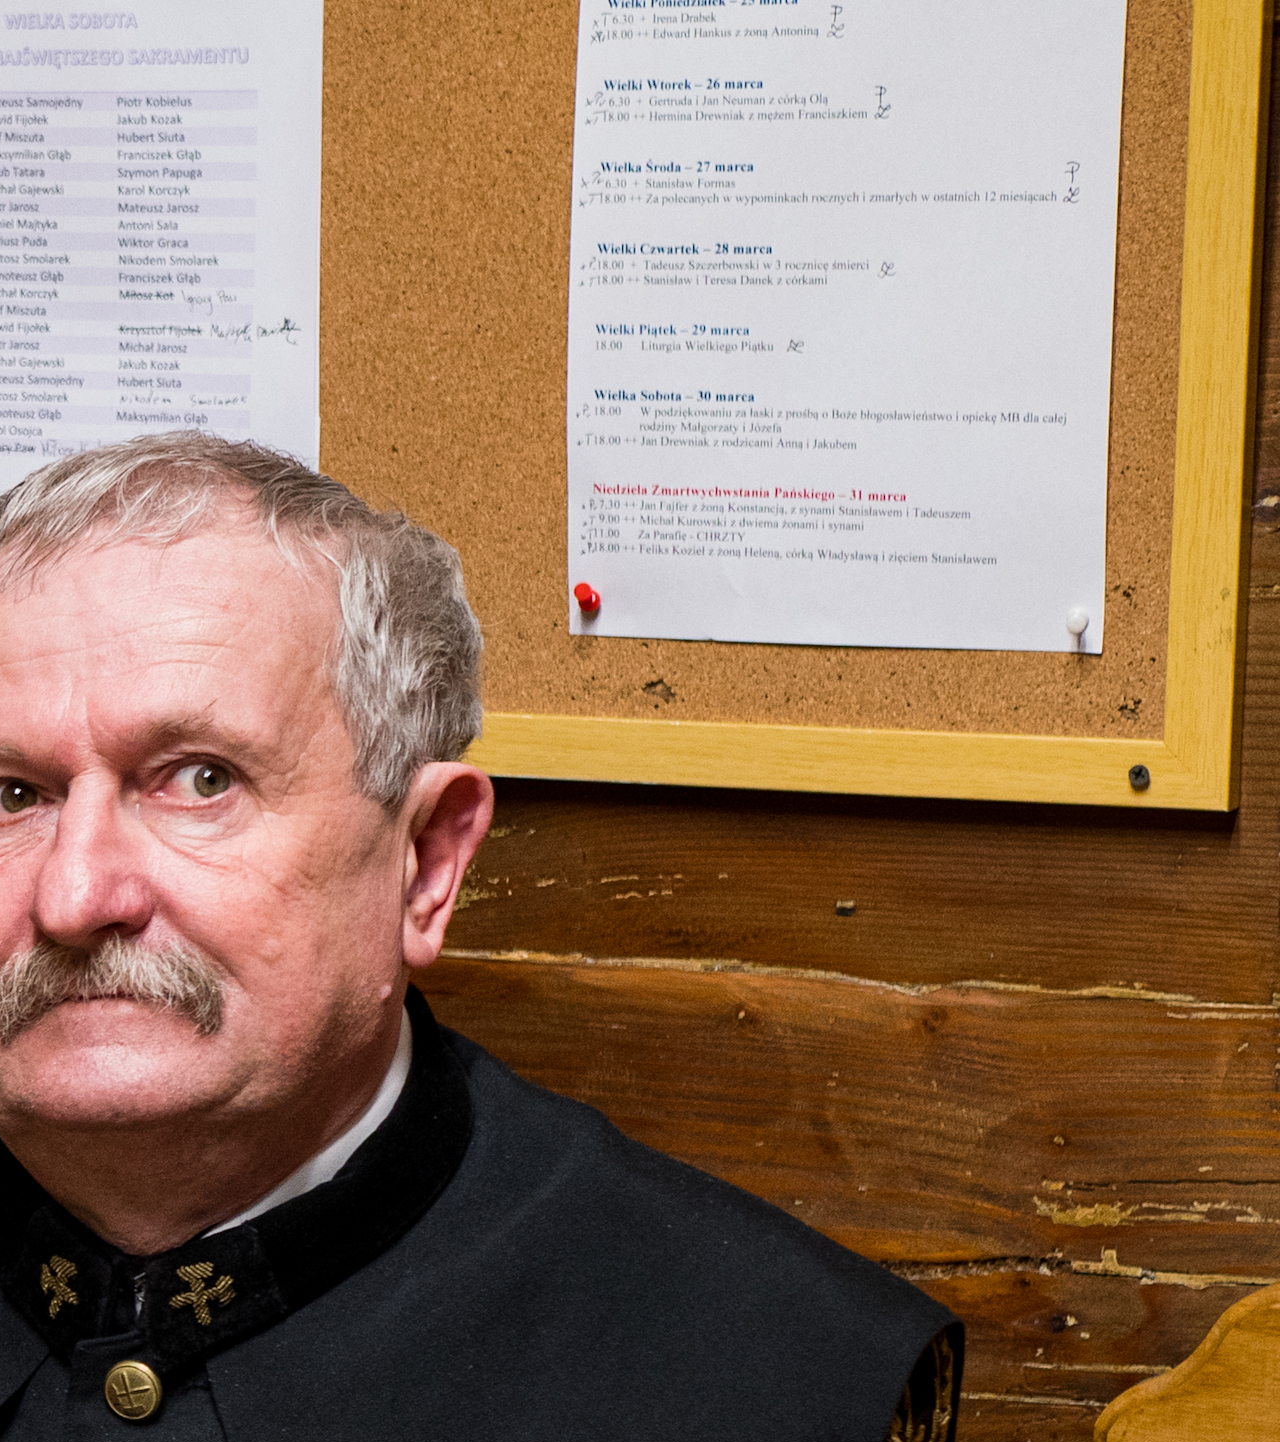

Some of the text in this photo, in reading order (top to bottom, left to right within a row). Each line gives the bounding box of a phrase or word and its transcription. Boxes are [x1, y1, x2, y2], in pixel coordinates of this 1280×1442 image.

[5, 12, 138, 30] WIELKA SOBOTA
[128, 48, 250, 66] SAKRAMENTU
[603, 78, 764, 91] Wielki Wtorek 26 marca
[26, 97, 84, 111] Samojedny
[116, 96, 193, 107] Piotr Kobielus
[116, 114, 183, 125] Jakub Kozak
[602, 112, 630, 122] 18.00
[648, 111, 692, 121] Hermina
[695, 111, 745, 121] Drewniak
[757, 110, 795, 123] mężem
[798, 110, 868, 119] Franciszkiem
[5, 132, 45, 143] Miszuta
[117, 132, 186, 142] Hubert Siuta
[117, 150, 202, 163] Franciszek Głąb
[13, 167, 46, 177] Tatara
[600, 158, 754, 173] Wielka Środa 27 marca
[117, 167, 203, 181] Szymon Papuga
[605, 178, 736, 189] 6.30 Stanisław Formas
[117, 185, 191, 198] Karol Korczyk
[645, 194, 659, 204] Za
[661, 194, 719, 207] polecanych
[735, 193, 809, 206] wypominkach
[811, 193, 860, 205] rocznych
[869, 192, 918, 205] zmarłych
[933, 192, 980, 202] ostatnich
[984, 191, 996, 201] 12
[999, 191, 1057, 204] miesiącach
[117, 203, 199, 213] Mateusz Jarosz
[117, 220, 179, 231] Antoni Sala
[117, 238, 189, 248] Wiktor Graca
[597, 243, 773, 255] Wielki Czwartek 28 marca
[118, 255, 219, 266] Nikodem Smolarek
[597, 260, 624, 270] 18.00
[644, 260, 686, 270] Tadeusz
[688, 260, 759, 270] Szczerbowski
[784, 260, 830, 273] rocznicę
[832, 260, 870, 270] śmierci
[118, 273, 201, 286] Franciszek Głąb
[595, 324, 751, 338] Wielki Piątek 29 marca
[119, 342, 188, 353] Michał Jarosz
[595, 341, 623, 351] 18.00
[641, 341, 682, 354] Liturgia
[685, 341, 738, 354] Wielkiego
[741, 342, 774, 354] Piątku
[117, 360, 181, 370] Jakub Kozak
[117, 377, 182, 388] Hubert Siuta
[593, 389, 756, 402] Wielka Sobota 30 marca
[116, 412, 209, 426] Maksymilian Głąb
[592, 483, 907, 502] Niedziela Zmartwychwstania Pańskiego 31 marca
[638, 530, 651, 540] Za
[696, 532, 746, 542] CHRZTY
